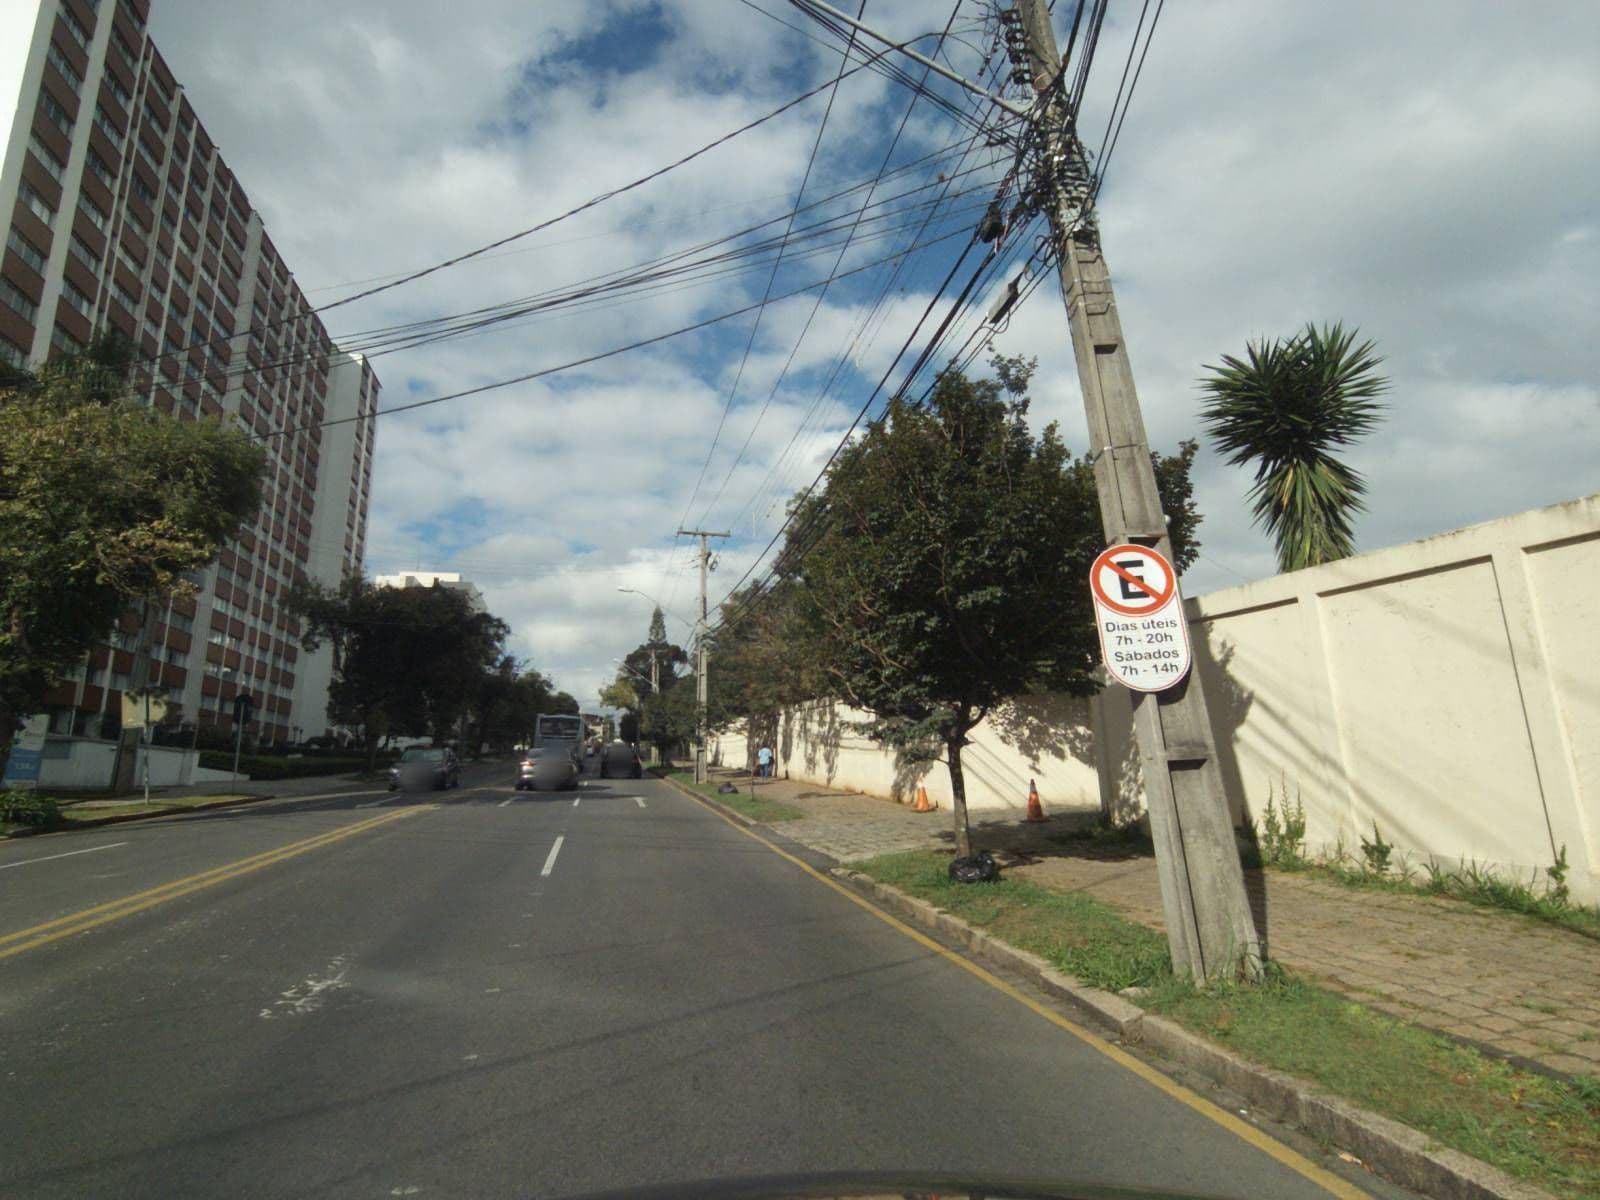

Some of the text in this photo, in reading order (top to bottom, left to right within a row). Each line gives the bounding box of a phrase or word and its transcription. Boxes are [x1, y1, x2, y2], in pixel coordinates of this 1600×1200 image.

[1116, 559, 1150, 600] E
[1105, 621, 1138, 633] Dias
[1115, 635, 1133, 646] 7h
[1146, 632, 1174, 644] 20h
[1121, 665, 1138, 676] 7h
[1152, 663, 1179, 674] 14h
